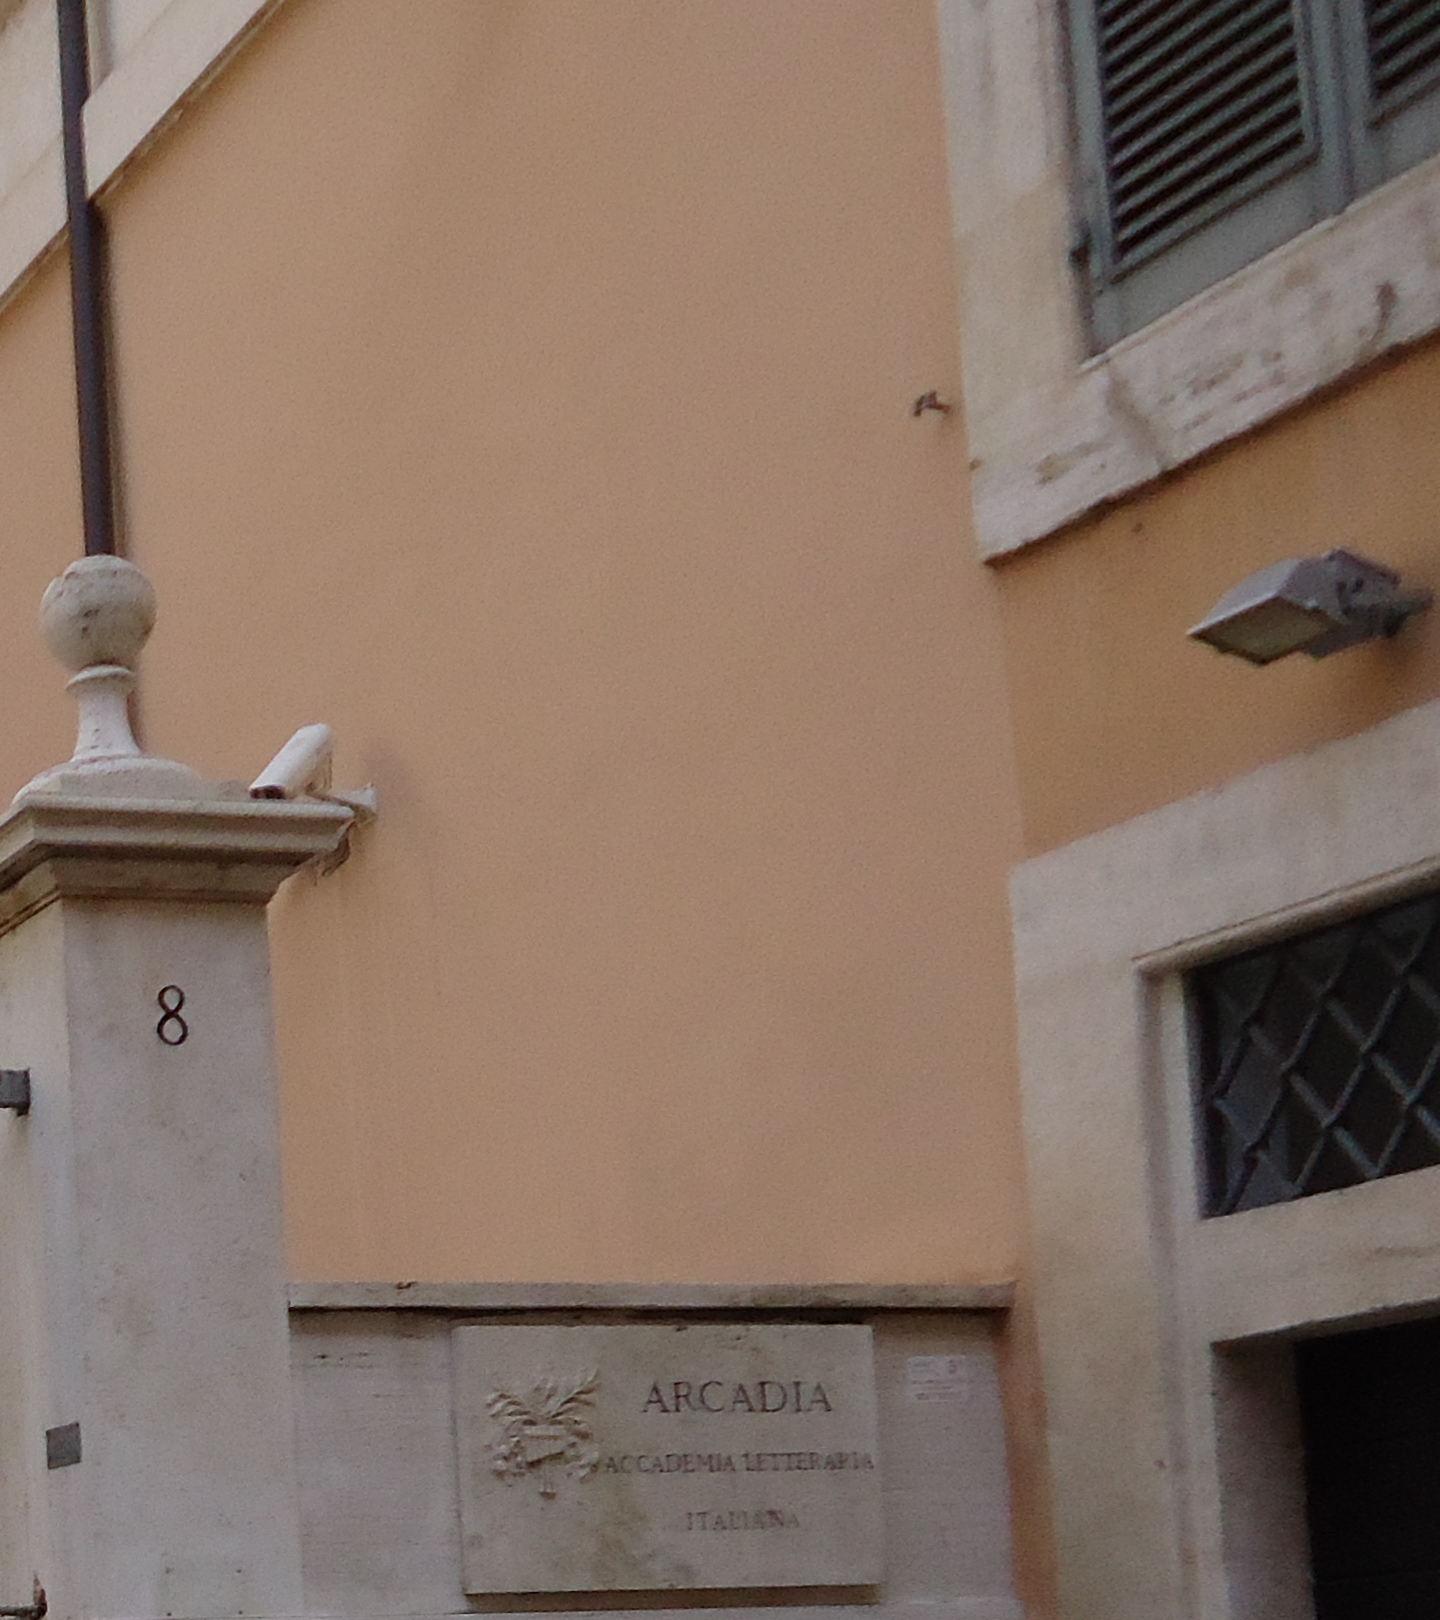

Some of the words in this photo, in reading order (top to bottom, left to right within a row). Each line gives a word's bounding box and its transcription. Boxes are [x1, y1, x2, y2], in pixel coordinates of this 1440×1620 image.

[157, 985, 188, 1046] 8
[641, 1380, 834, 1413] ARCADIA
[606, 1452, 737, 1474] ACCADEMIA
